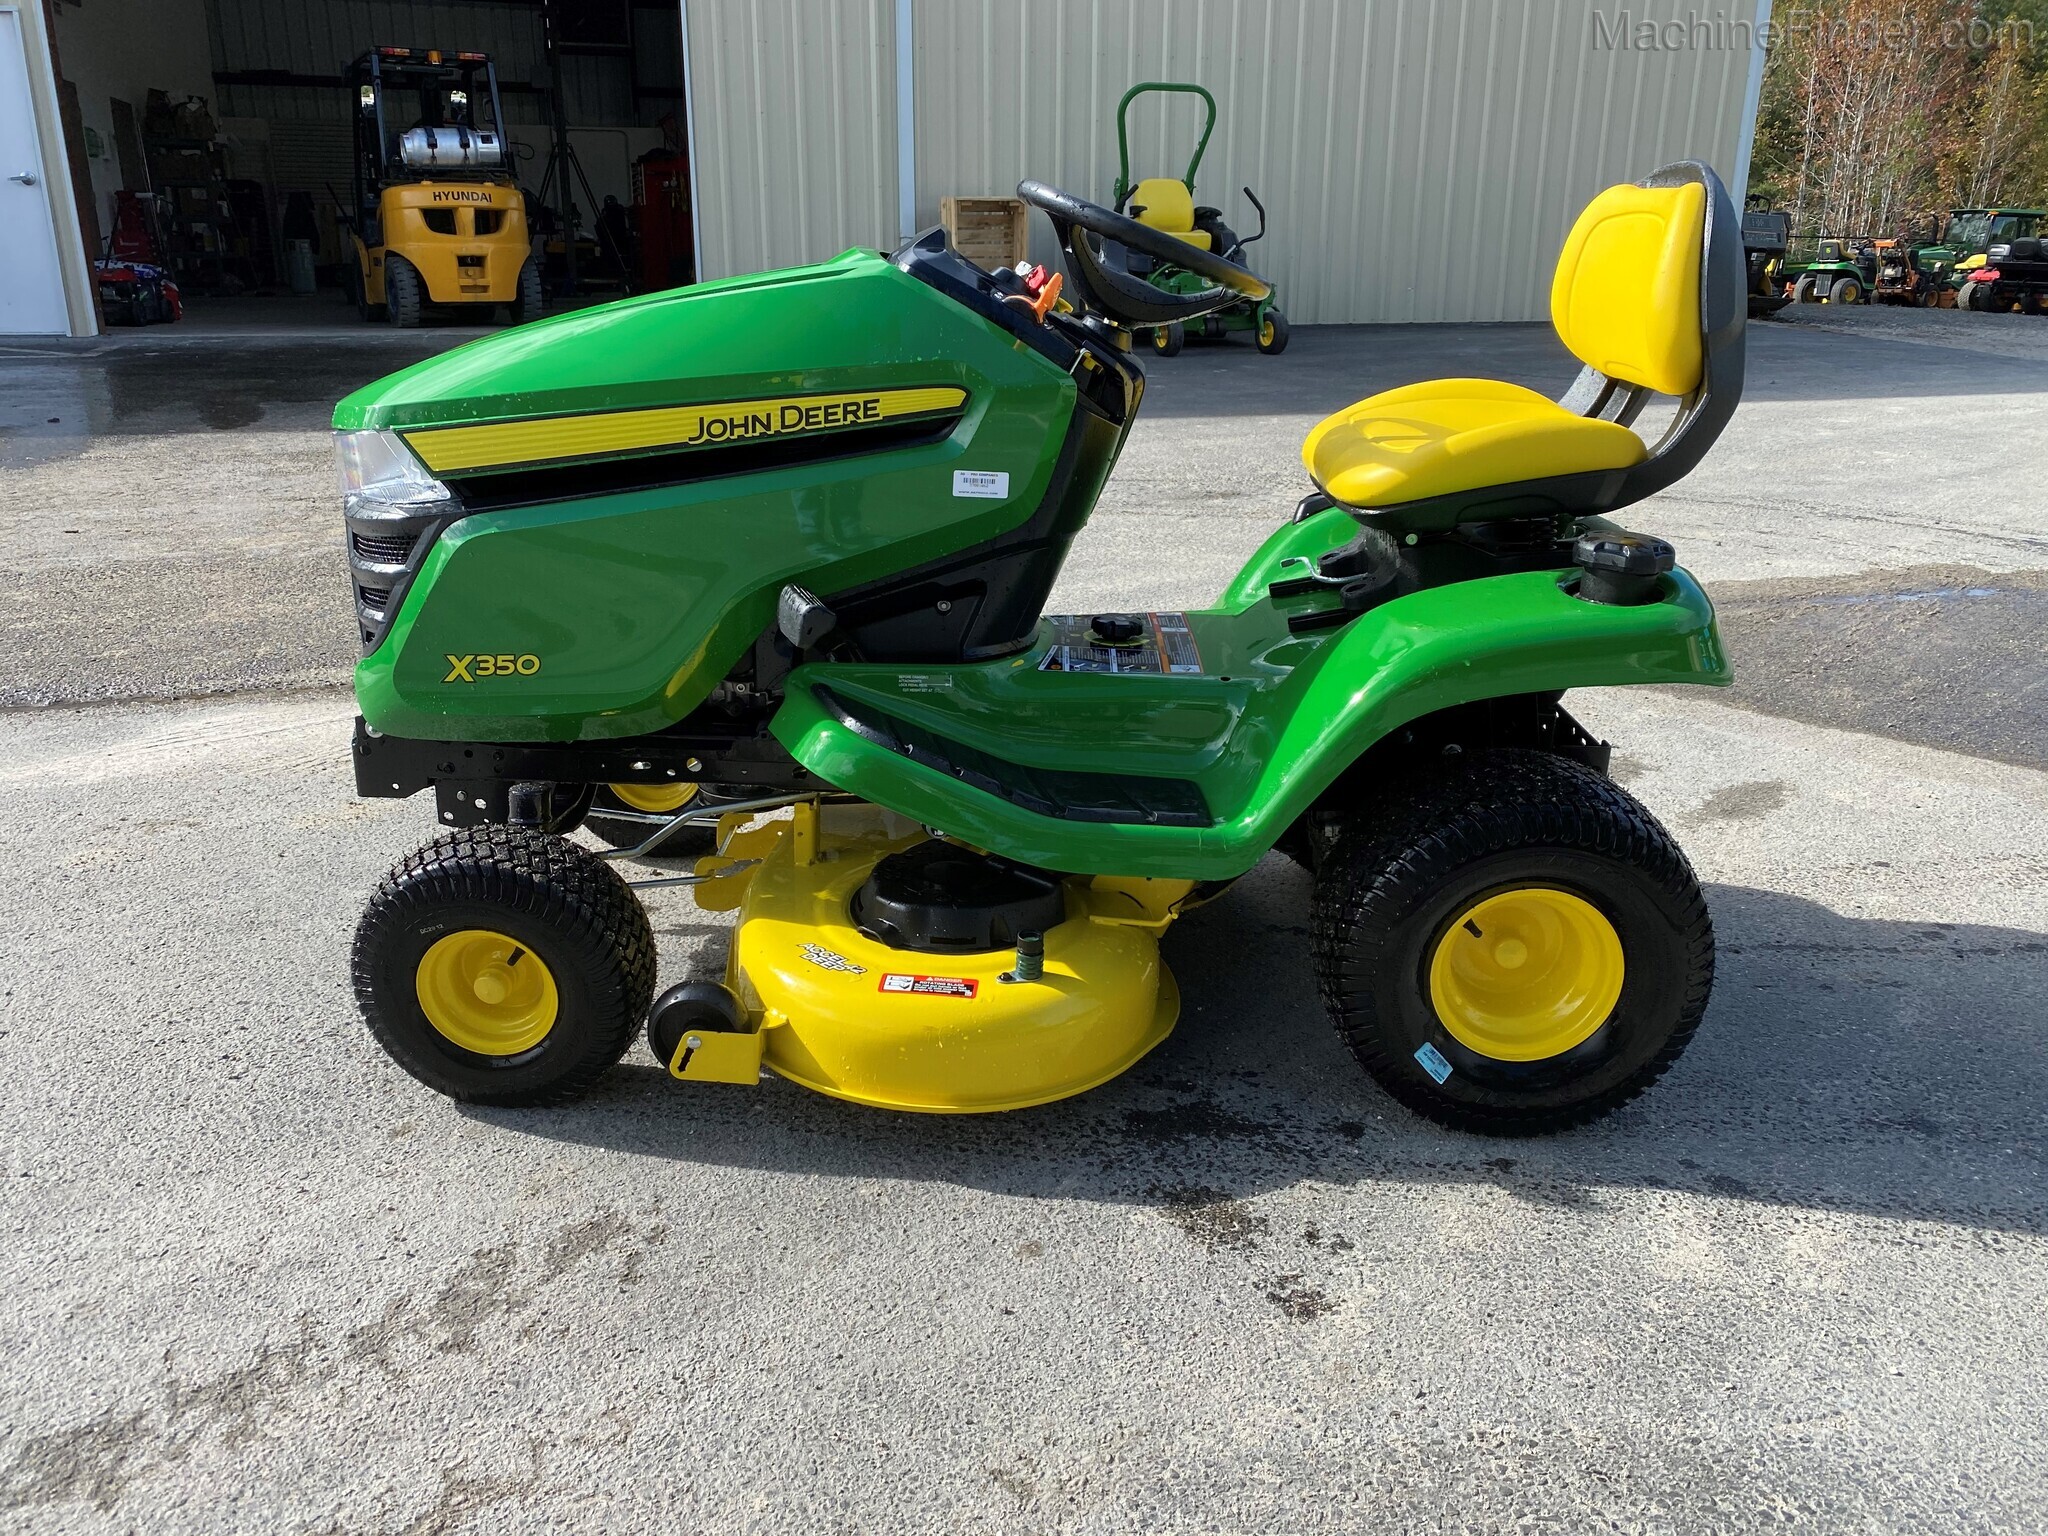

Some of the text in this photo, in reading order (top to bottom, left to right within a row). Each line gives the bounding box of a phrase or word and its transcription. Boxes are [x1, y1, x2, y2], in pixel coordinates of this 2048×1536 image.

[432, 191, 493, 203] HYUNDAI
[687, 398, 880, 442] JOHN DEERE
[441, 653, 541, 683] X350
[796, 942, 849, 966] ACCEL
[799, 952, 847, 971] DEEP
